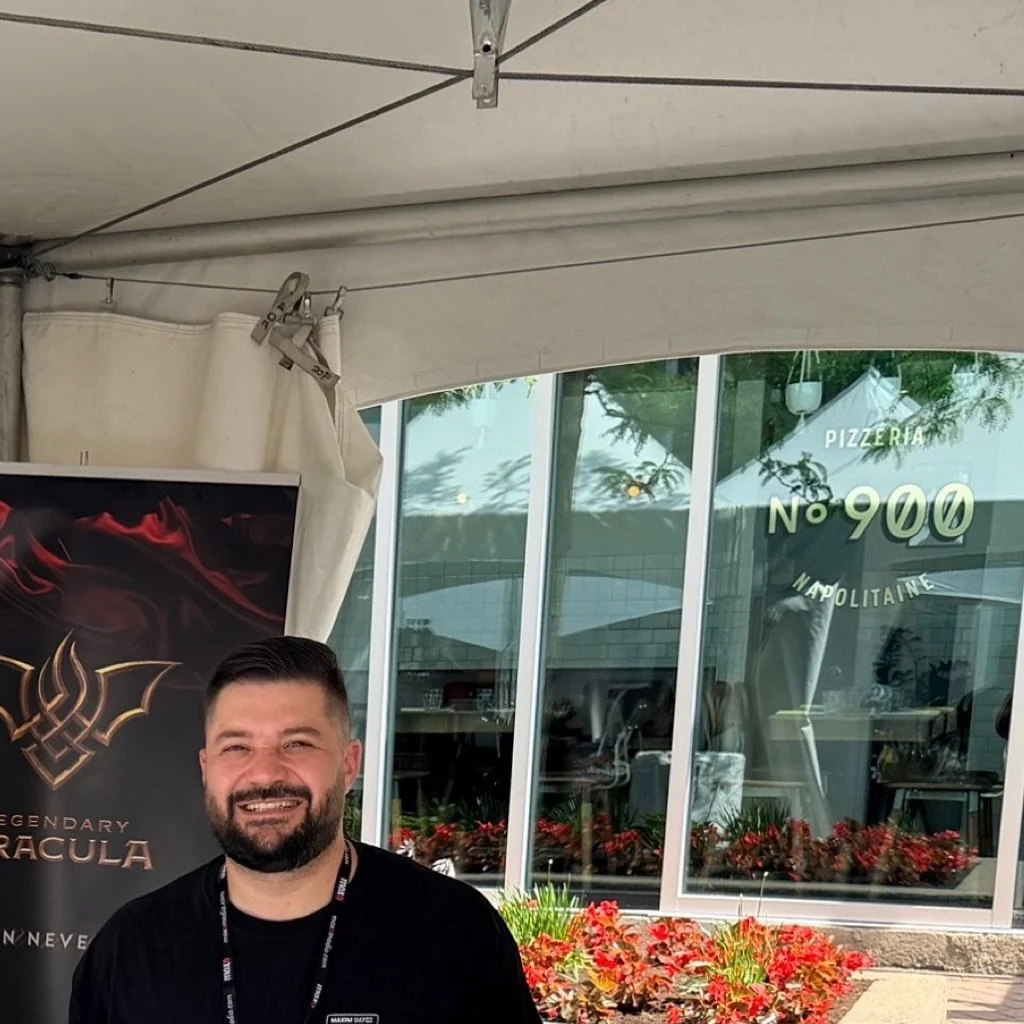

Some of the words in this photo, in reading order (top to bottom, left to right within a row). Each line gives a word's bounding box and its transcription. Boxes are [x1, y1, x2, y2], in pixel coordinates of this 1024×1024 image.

[826, 427, 924, 448] PIZZERIA
[843, 482, 974, 541] 900
[792, 571, 936, 608] NAPOLITAINE
[27, 930, 89, 951] NEVE
